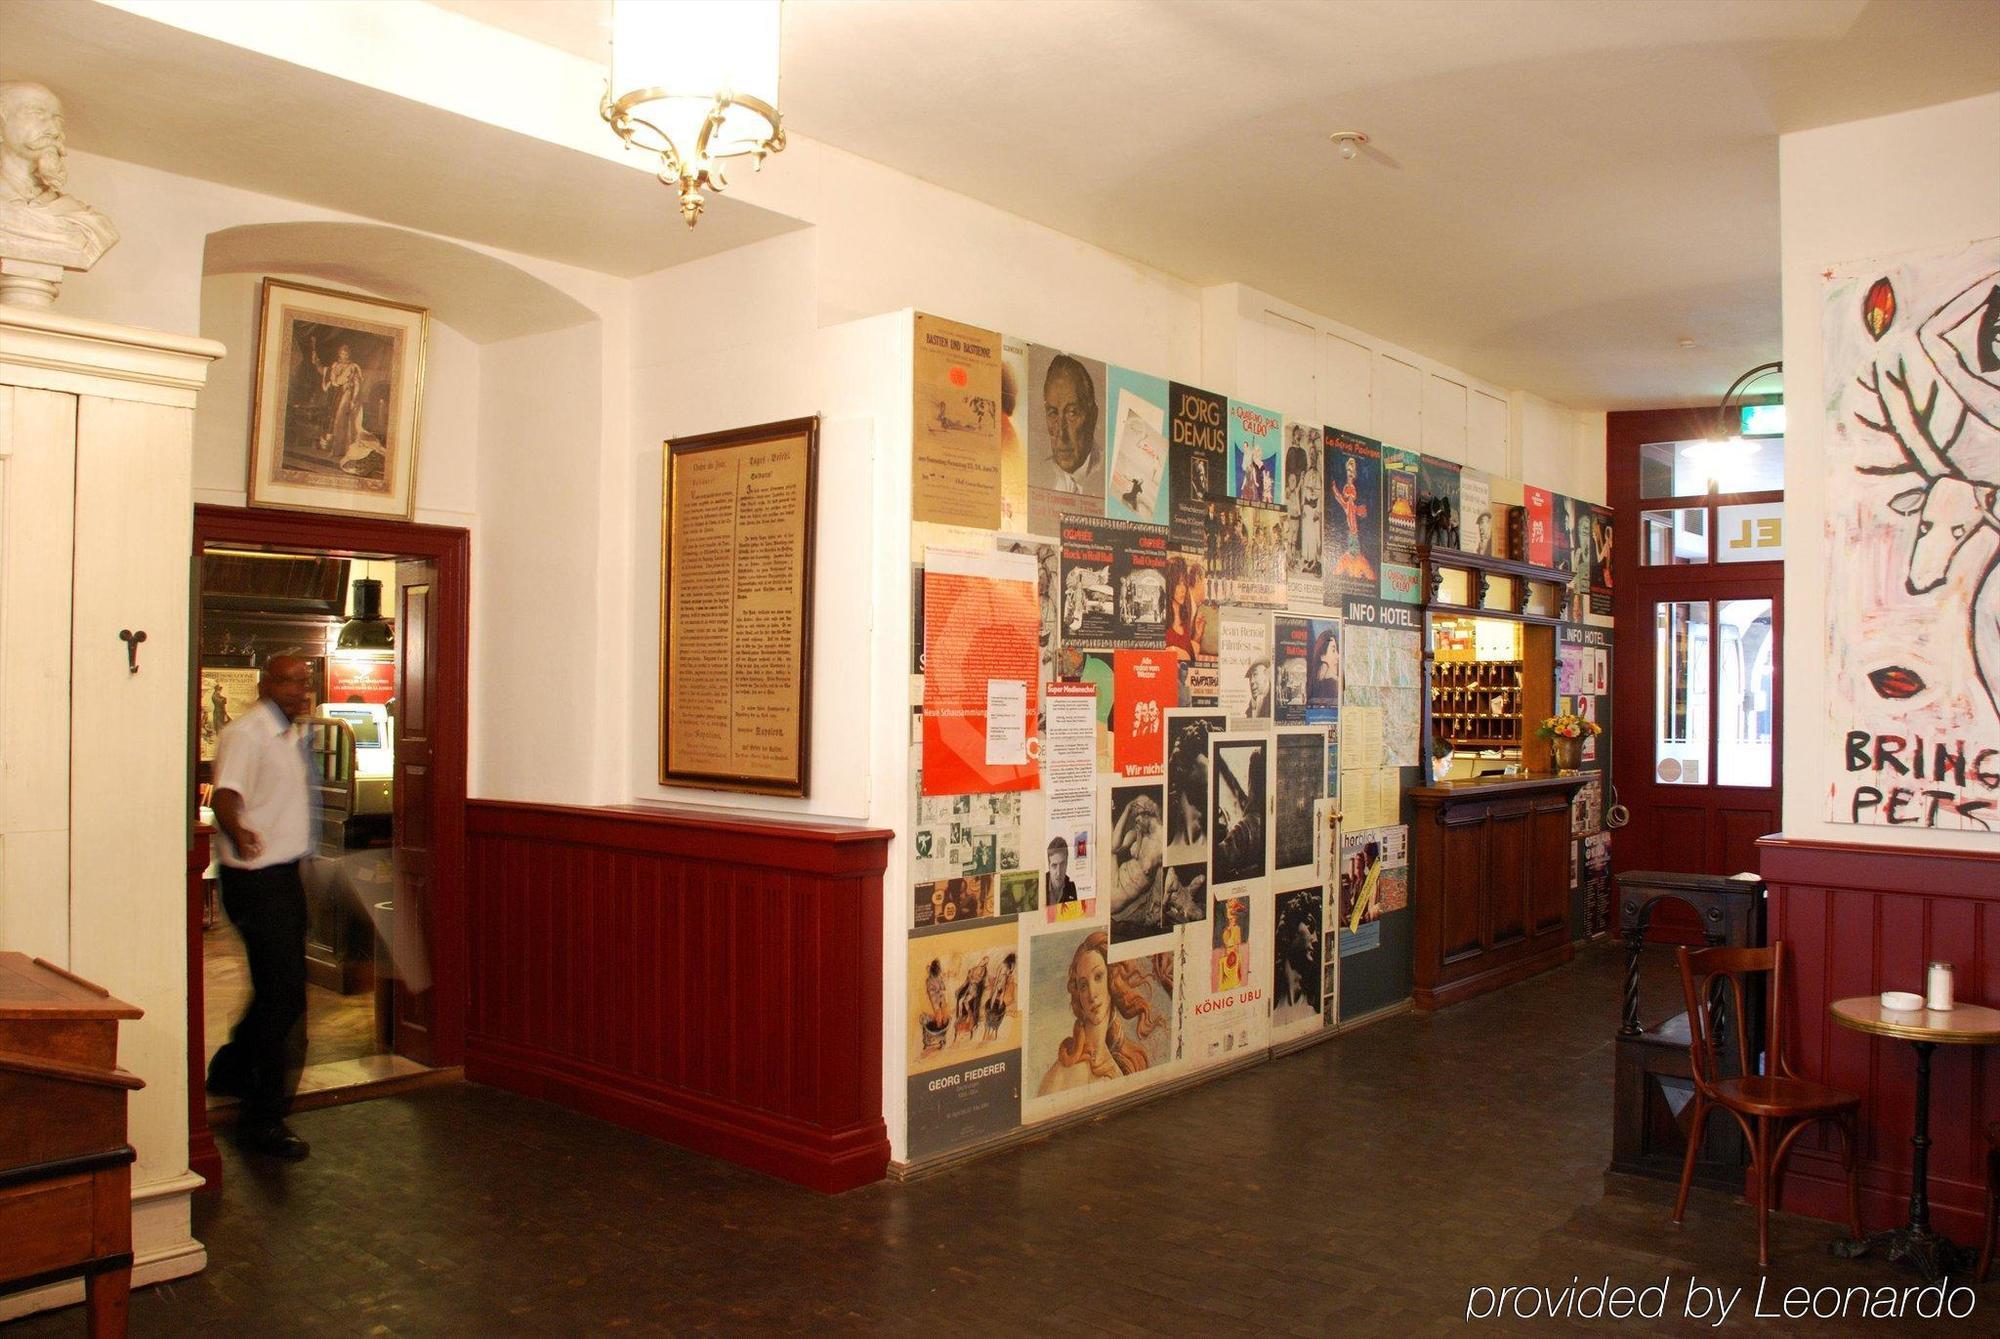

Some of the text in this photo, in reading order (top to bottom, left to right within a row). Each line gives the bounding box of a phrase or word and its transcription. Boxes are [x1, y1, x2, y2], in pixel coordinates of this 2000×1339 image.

[1179, 393, 1220, 426] JÖRG
[1173, 418, 1225, 453] DEMUS
[1349, 602, 1414, 626] INFO HOTEL
[1566, 628, 1606, 645] INFO HOTEL
[1126, 765, 1142, 776] Wir
[1845, 730, 2000, 791] BRING
[1195, 989, 1262, 1015] KÖNIG UBU
[928, 1075, 960, 1091] GEORG
[964, 1062, 1006, 1081] FIEDERER
